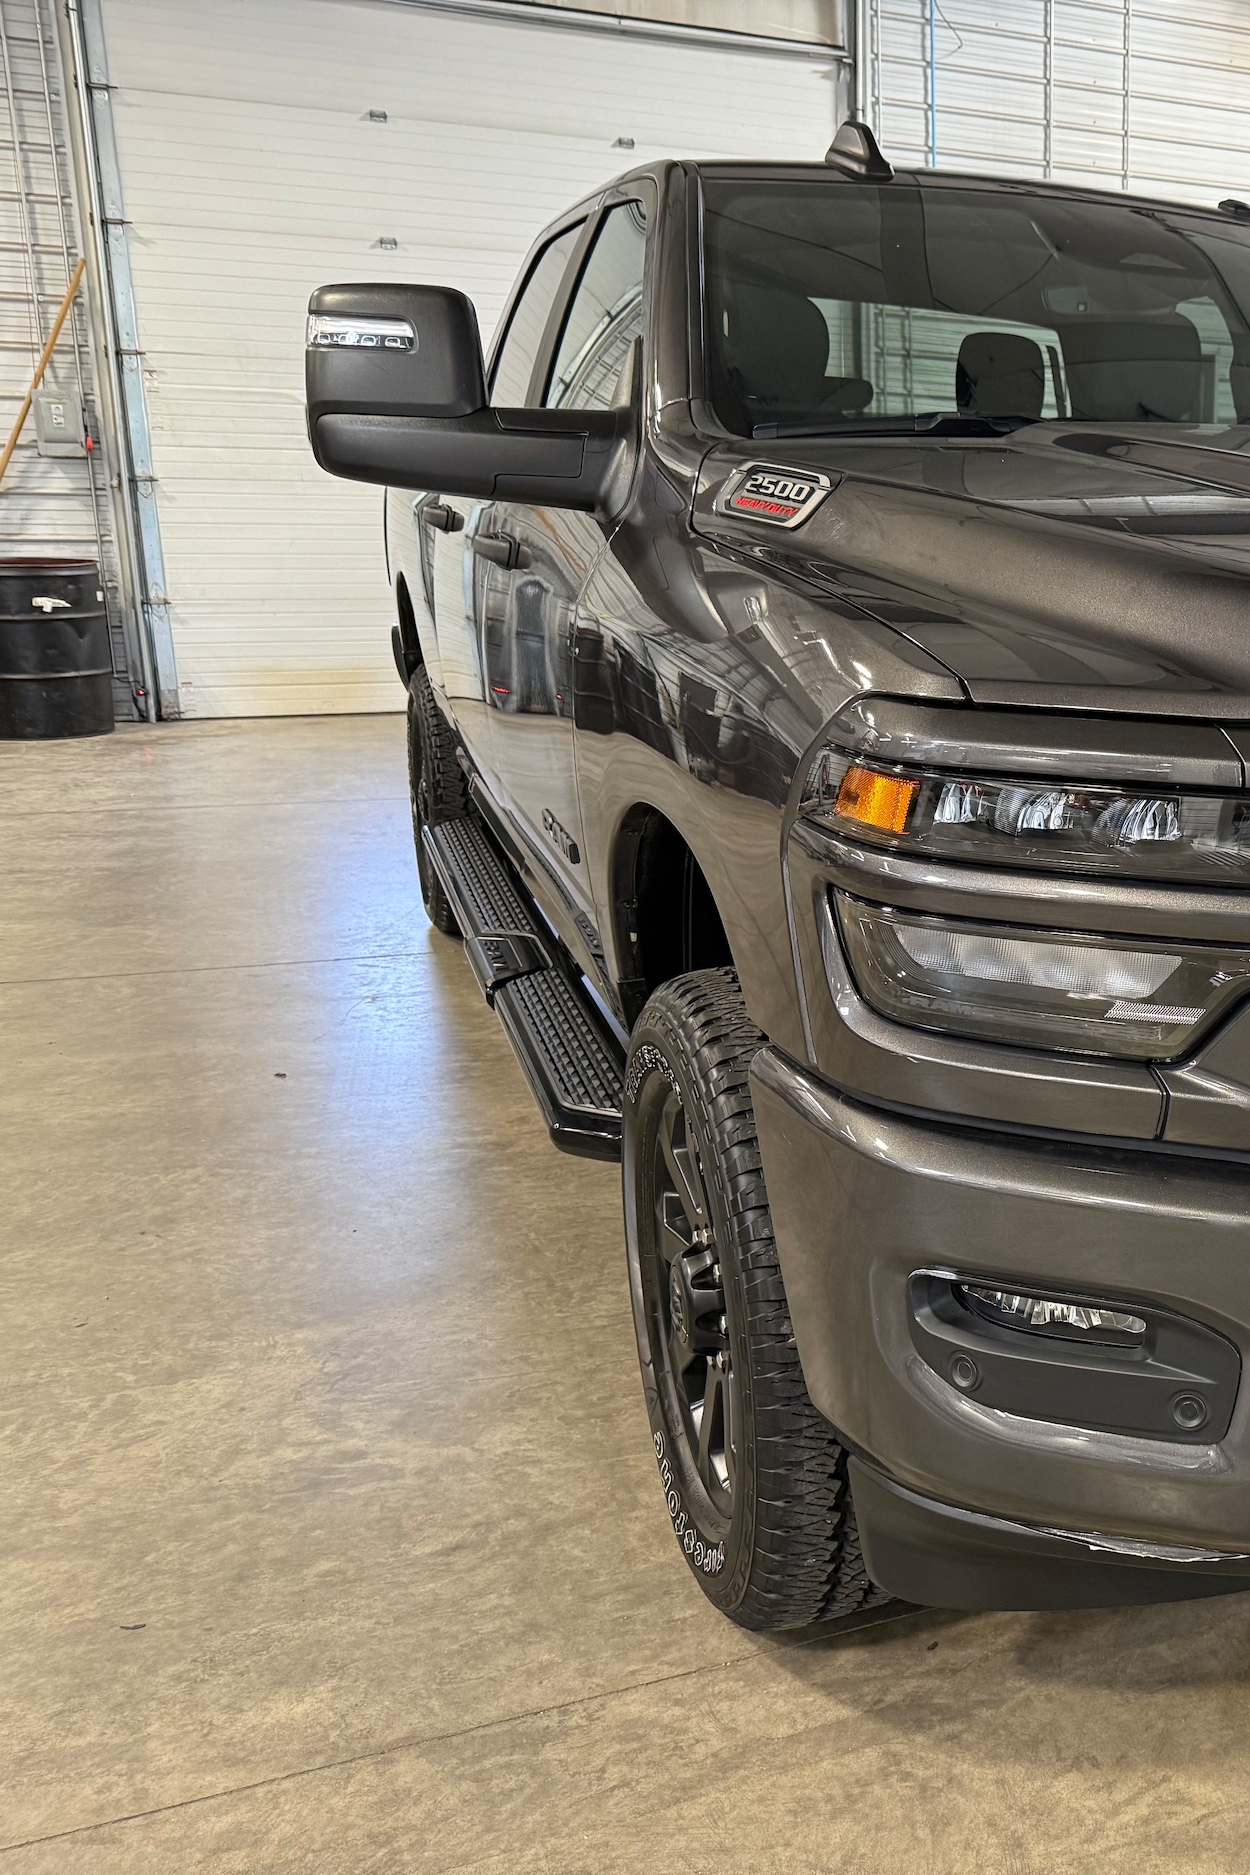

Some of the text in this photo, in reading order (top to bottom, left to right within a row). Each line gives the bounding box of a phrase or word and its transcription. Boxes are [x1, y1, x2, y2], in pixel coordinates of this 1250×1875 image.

[744, 475, 811, 501] 2500
[735, 496, 798, 517] HEAVY DUTY
[909, 995, 975, 1016] RAM
